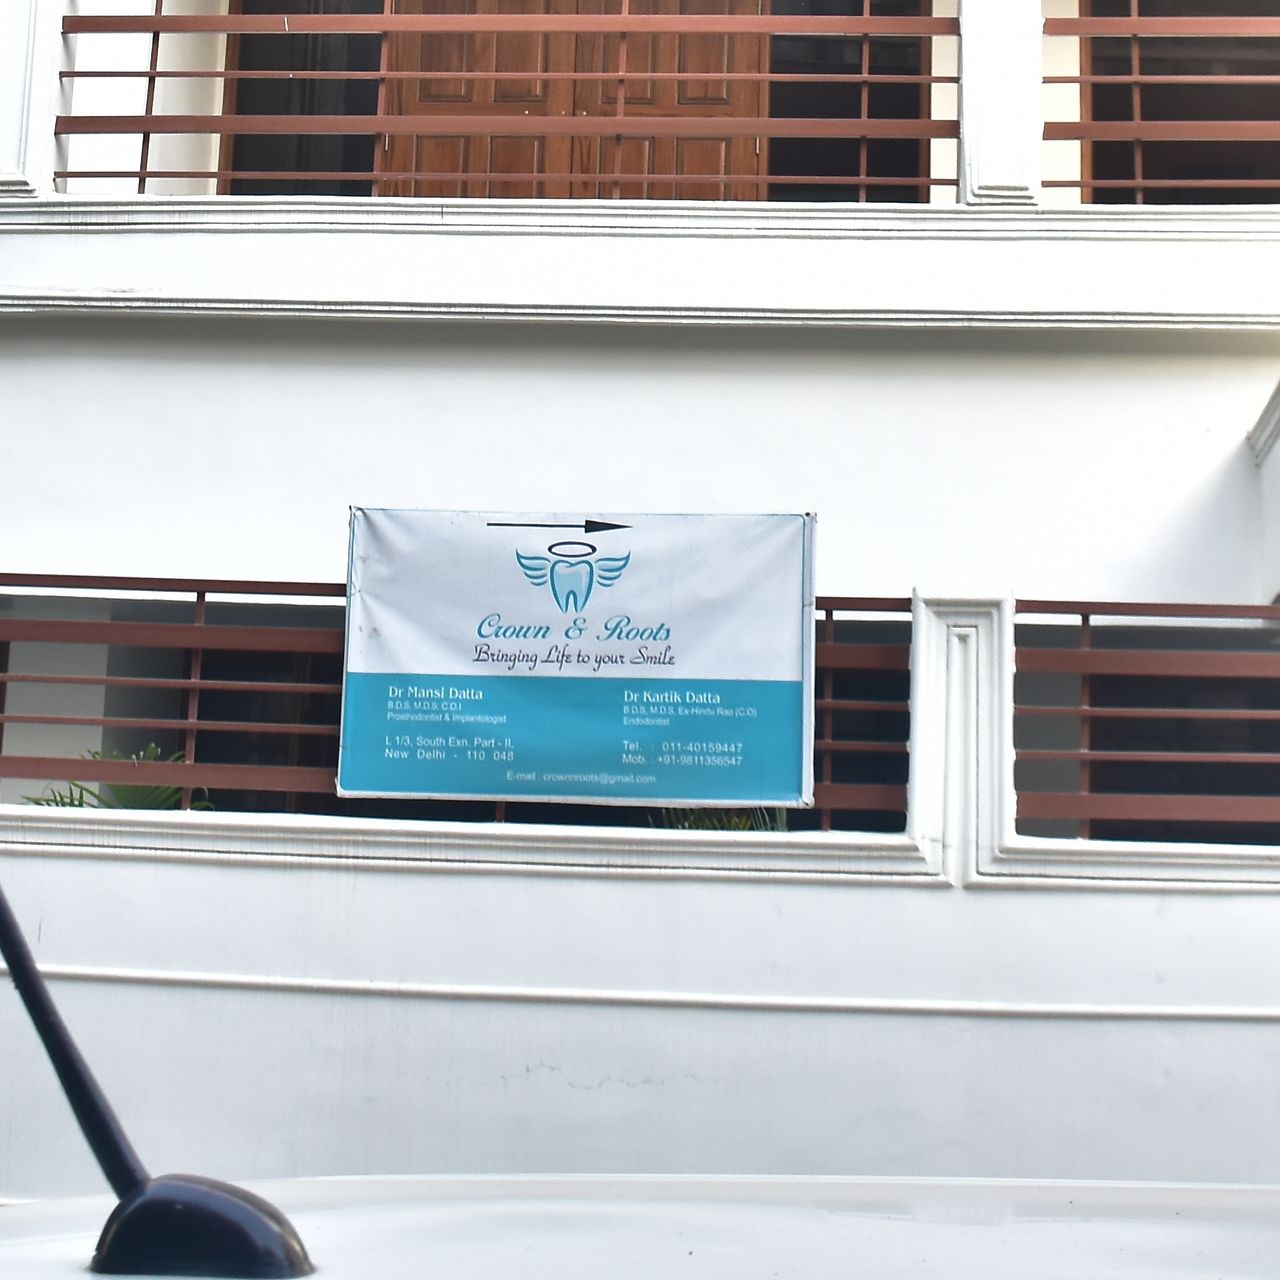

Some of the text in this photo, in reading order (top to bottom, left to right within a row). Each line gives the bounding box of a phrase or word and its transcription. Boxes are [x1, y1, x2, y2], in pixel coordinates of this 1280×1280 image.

[477, 613, 672, 642] Crown & Roots
[473, 643, 676, 672] Bringing Life to your Smile
[389, 686, 483, 700] Dr Mansi Datta
[624, 690, 721, 704] Dr Kartik Datta
[444, 712, 451, 721] &
[452, 713, 507, 724] Implantologist
[623, 716, 670, 727] Endodontist
[416, 736, 446, 747] South
[474, 738, 495, 748] Part
[662, 742, 743, 753] 011-40159447
[385, 748, 409, 759] New
[417, 749, 446, 760] Delhi
[467, 750, 486, 761] 110
[493, 751, 514, 761] 048
[506, 770, 536, 781] E-mail
